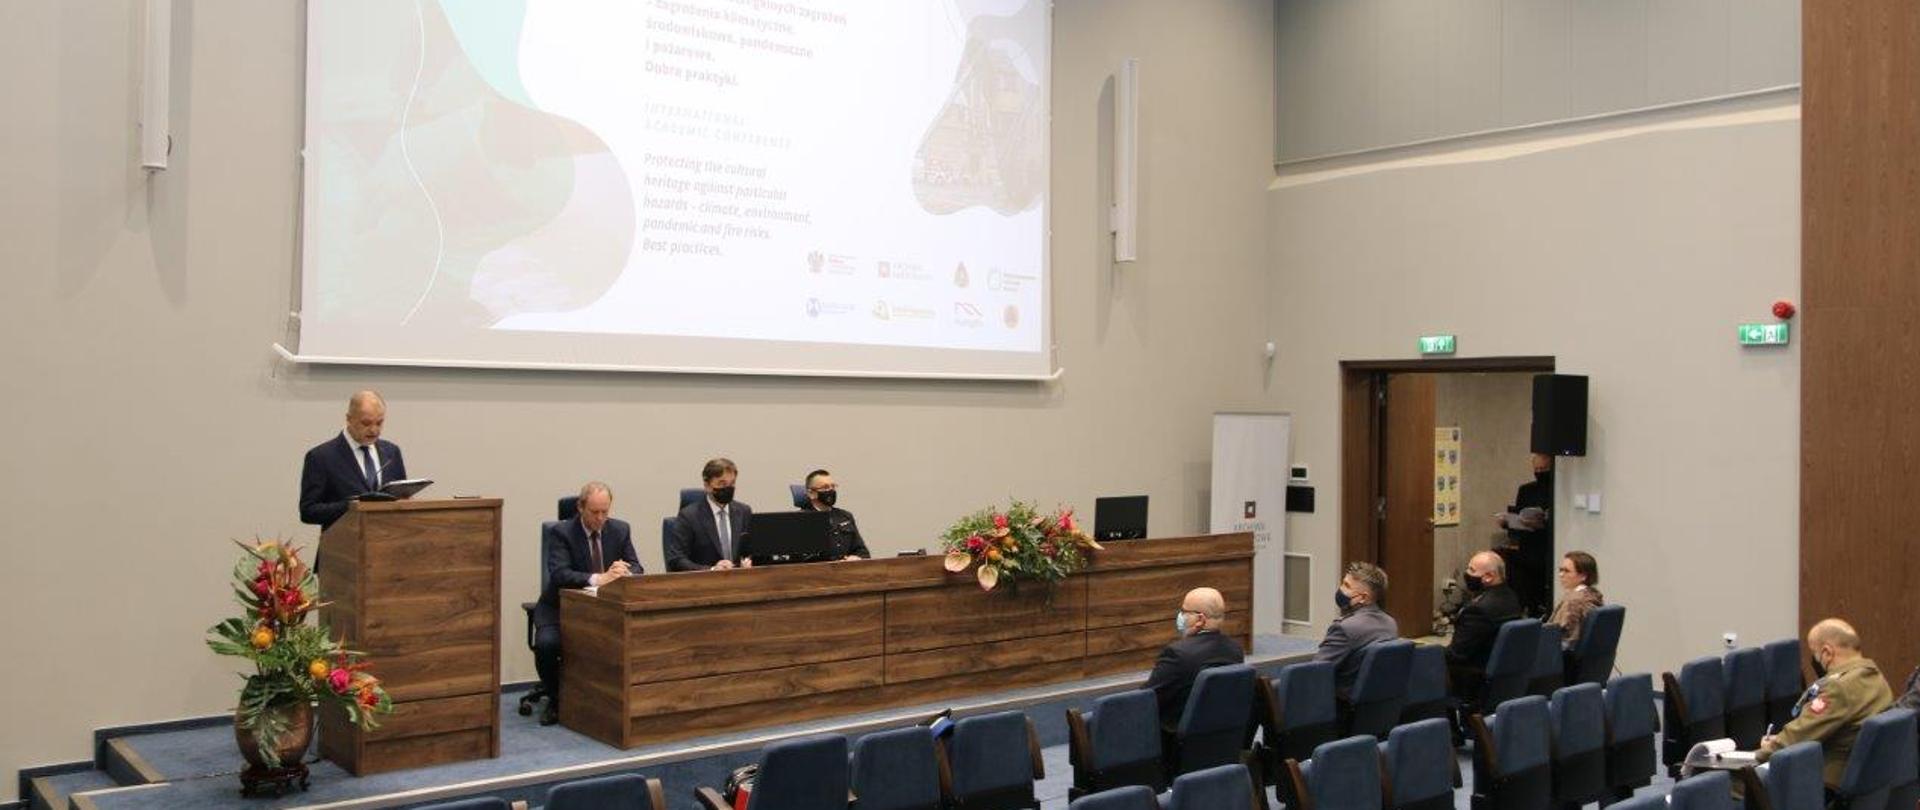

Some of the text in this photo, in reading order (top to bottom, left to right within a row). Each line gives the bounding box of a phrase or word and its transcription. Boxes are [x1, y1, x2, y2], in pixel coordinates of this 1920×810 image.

[643, 152, 768, 178] Protecting the cultural
[644, 173, 787, 200] heritage against particular
[643, 194, 688, 211] hazards
[699, 201, 741, 217] climate,
[744, 206, 813, 224] environment,
[642, 217, 698, 232] pandemic
[699, 220, 721, 235] and
[721, 222, 743, 239] fire
[643, 237, 667, 251] Best
